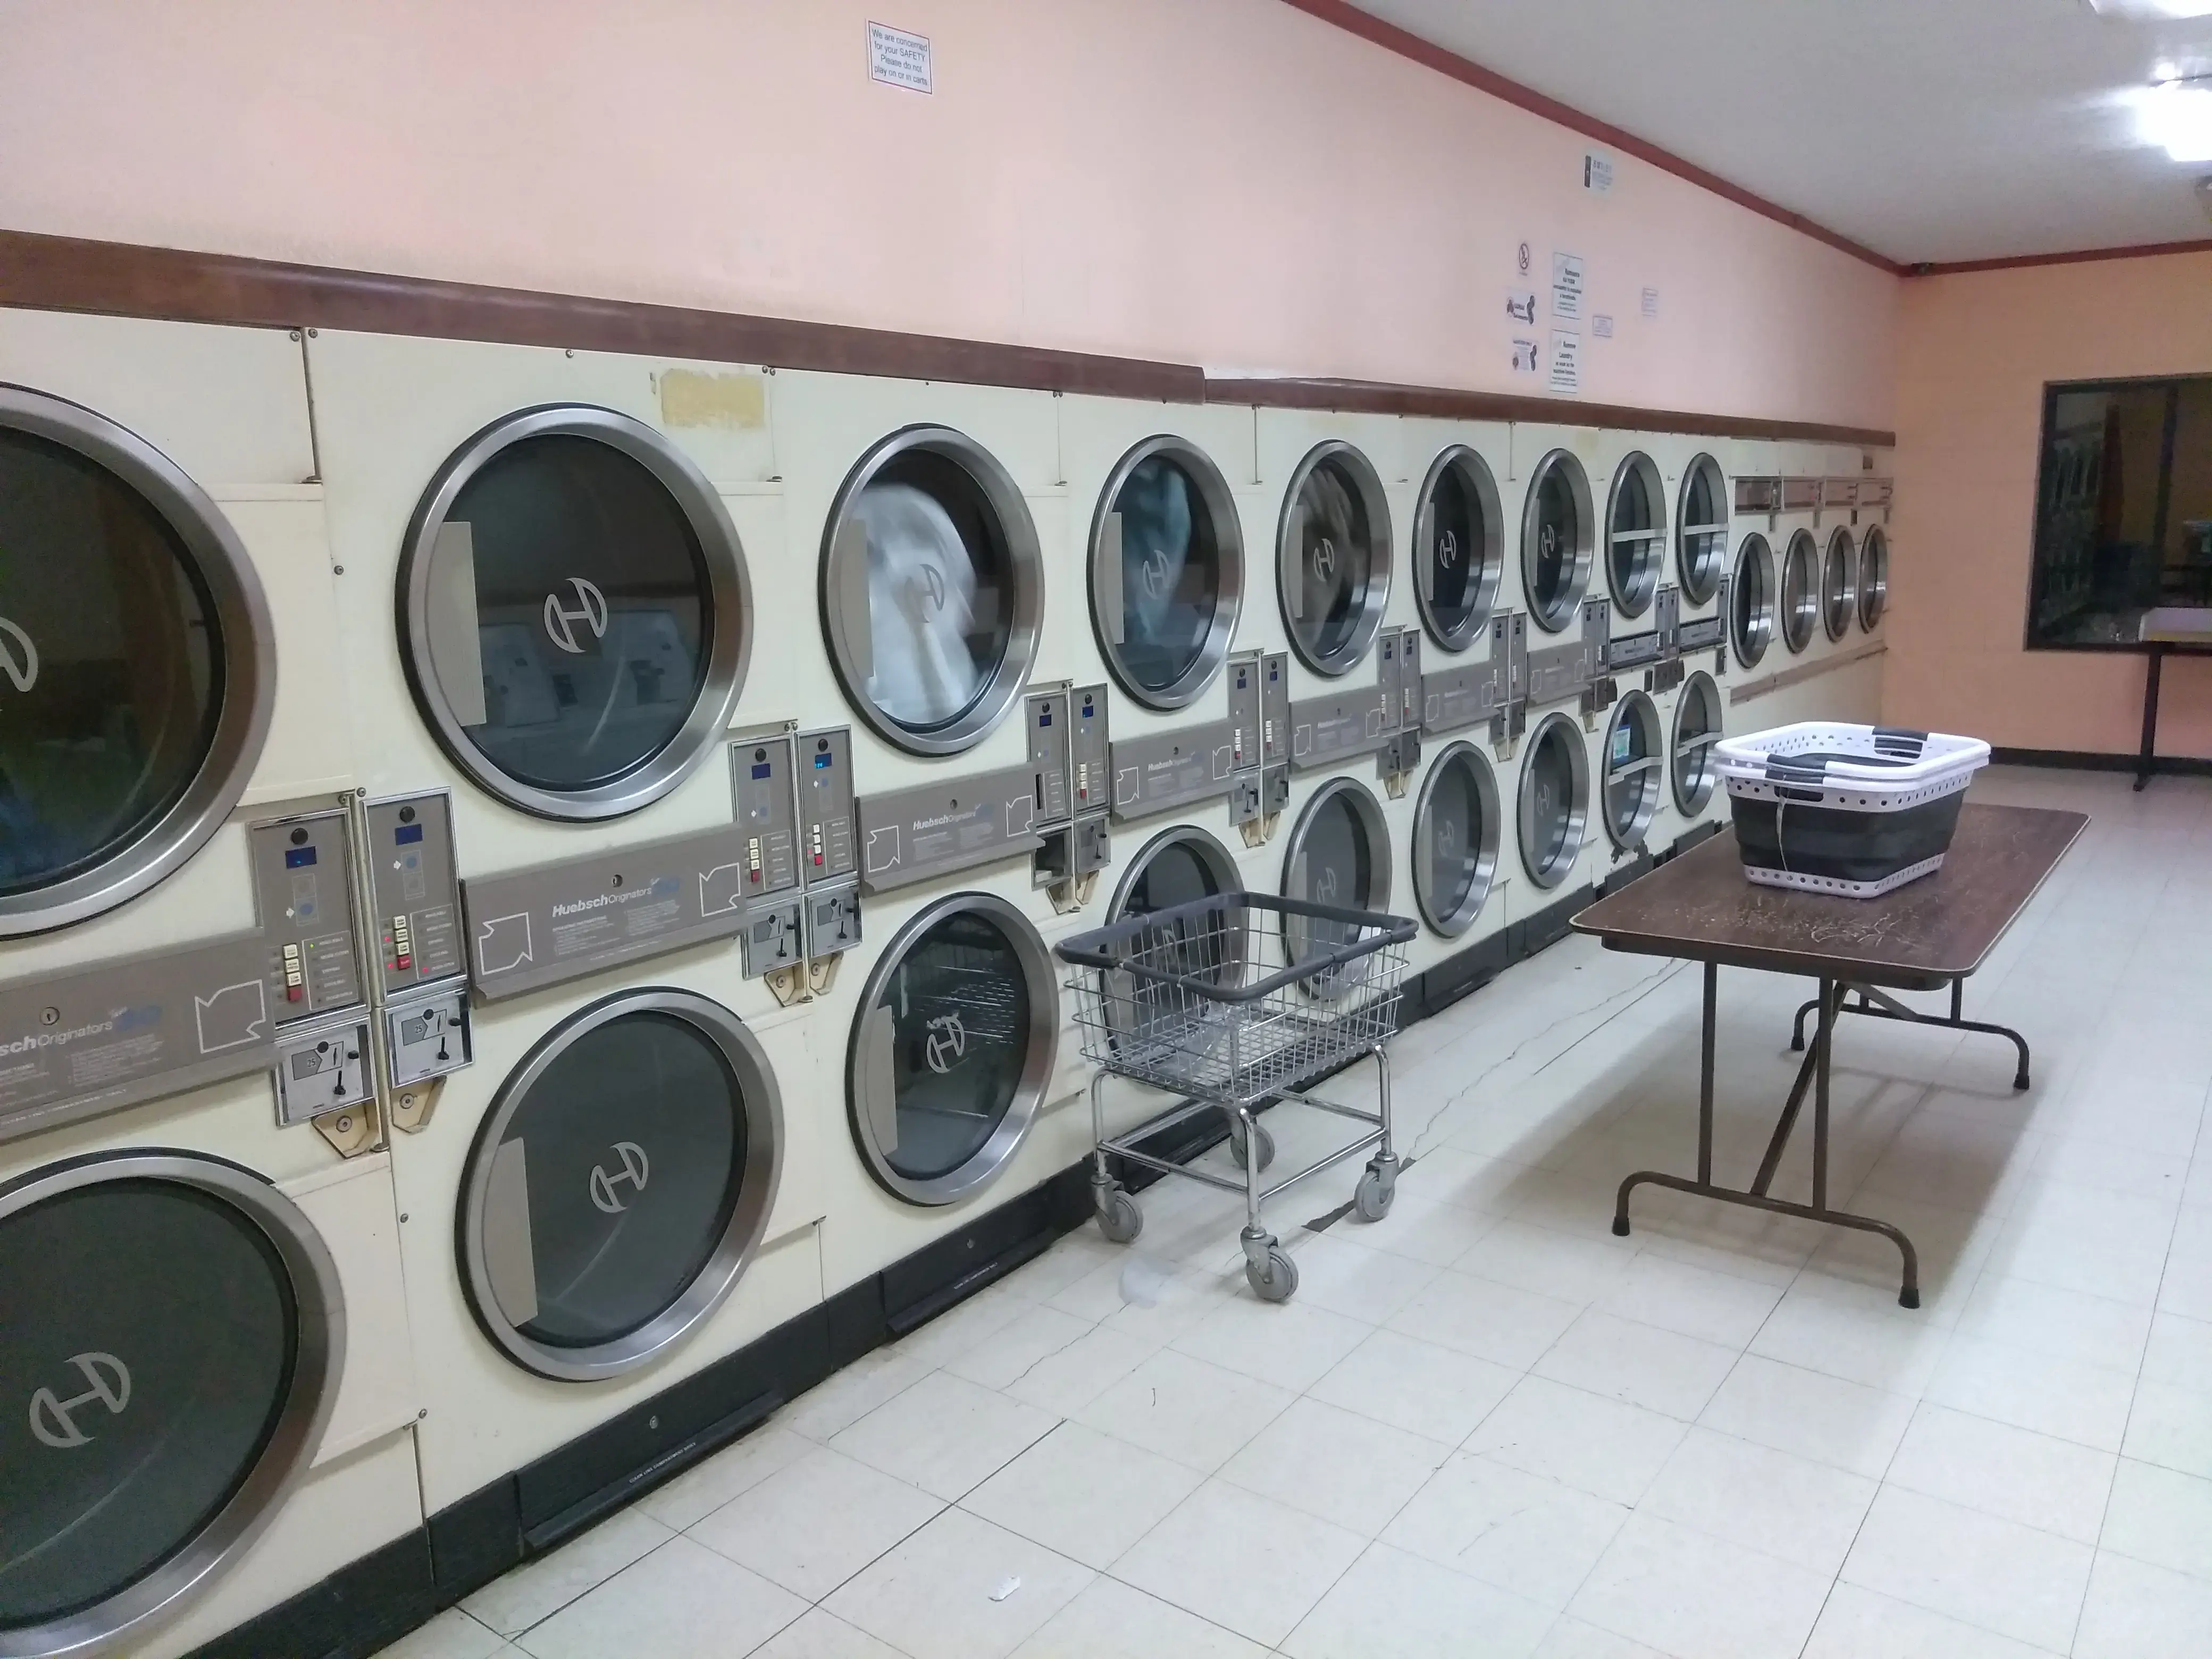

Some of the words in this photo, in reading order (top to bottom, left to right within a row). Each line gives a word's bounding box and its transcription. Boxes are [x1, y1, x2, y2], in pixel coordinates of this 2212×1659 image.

[872, 29, 883, 39] We
[896, 37, 927, 52] concerned
[874, 40, 883, 49] for
[884, 46, 898, 54] your
[900, 48, 925, 62] SAFETY
[881, 54, 901, 68] Please
[903, 61, 911, 69] do
[874, 65, 887, 77] play
[913, 76, 927, 85] carts
[552, 894, 608, 917] Huebsch
[608, 887, 652, 903] Originators
[37, 1021, 113, 1045] Originators
[415, 1025, 423, 1034] 25
[307, 1058, 316, 1068] 25
